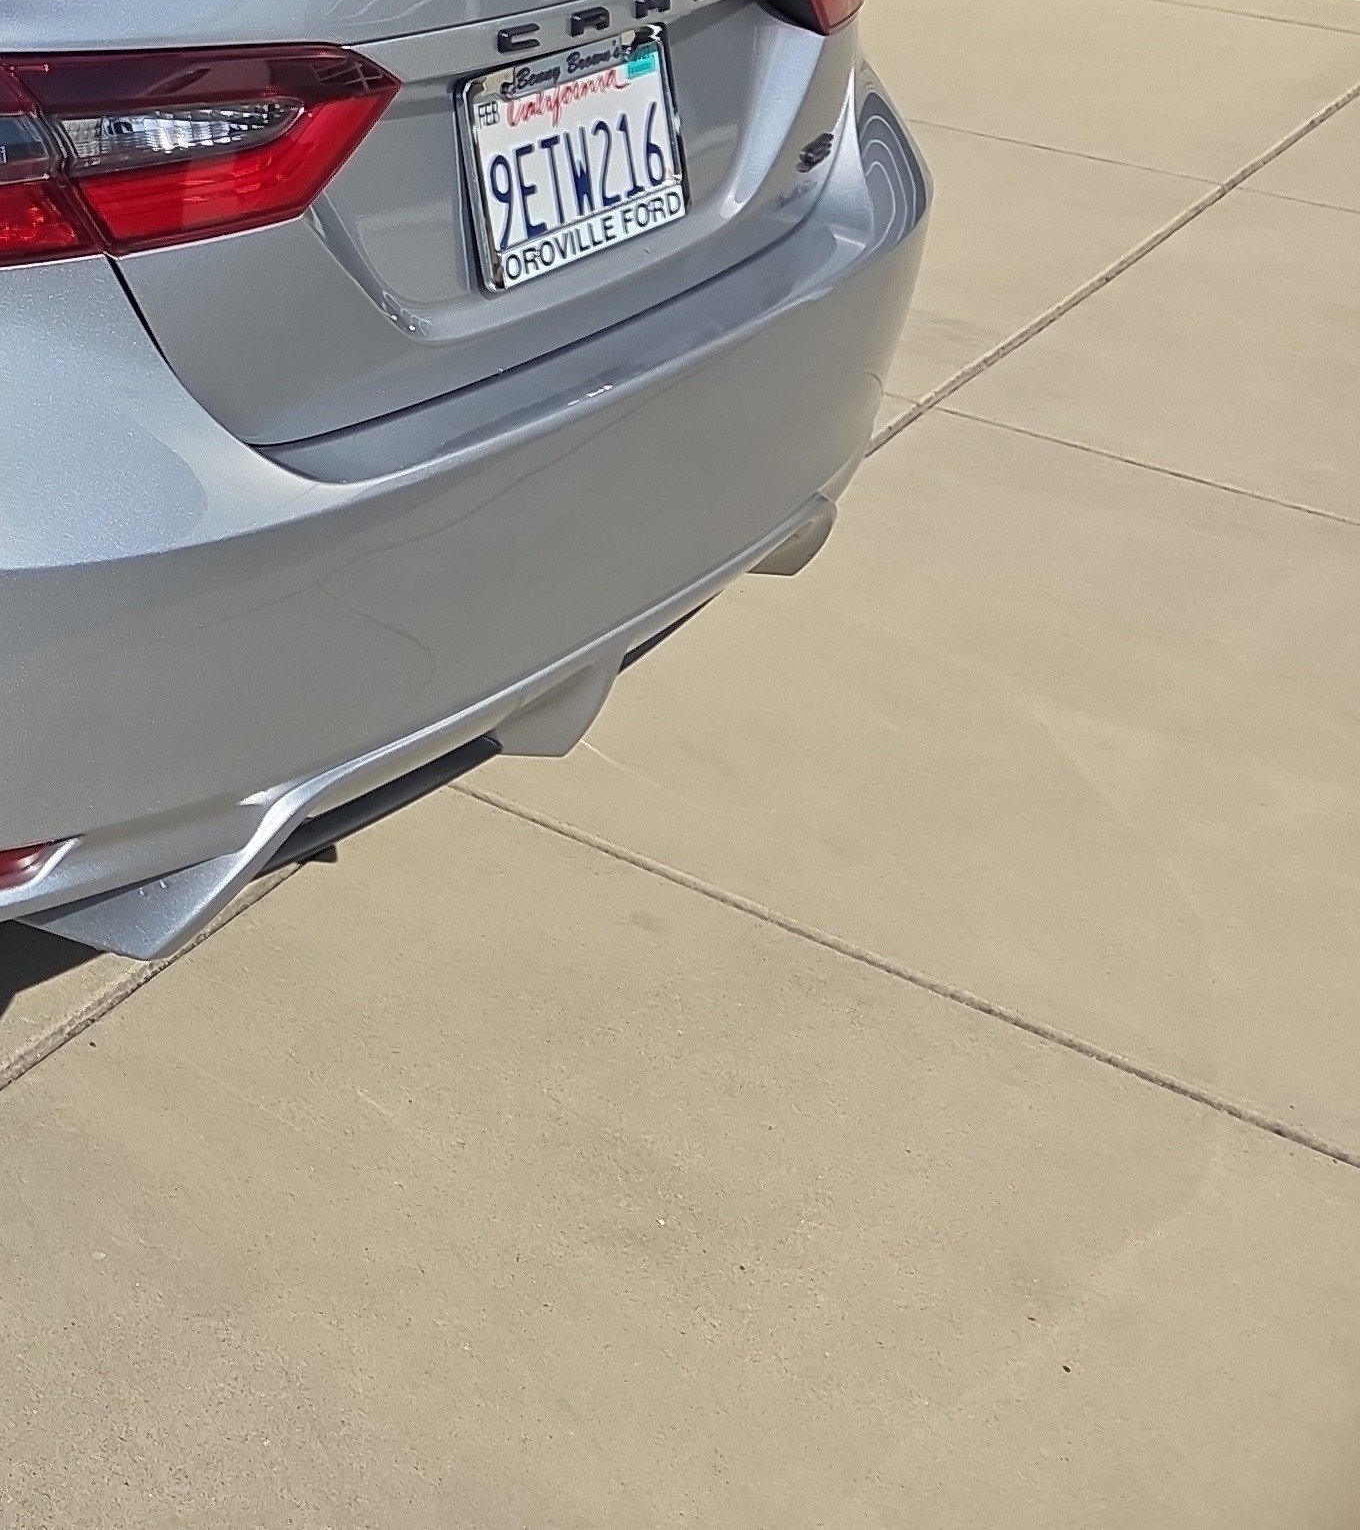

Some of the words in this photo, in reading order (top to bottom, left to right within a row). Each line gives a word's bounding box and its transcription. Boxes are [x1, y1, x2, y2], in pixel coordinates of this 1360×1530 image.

[477, 100, 500, 130] FEB
[506, 69, 631, 127] California
[489, 101, 666, 251] 9ETW216
[505, 216, 616, 281] OROVILLE
[621, 191, 682, 235] FORD
